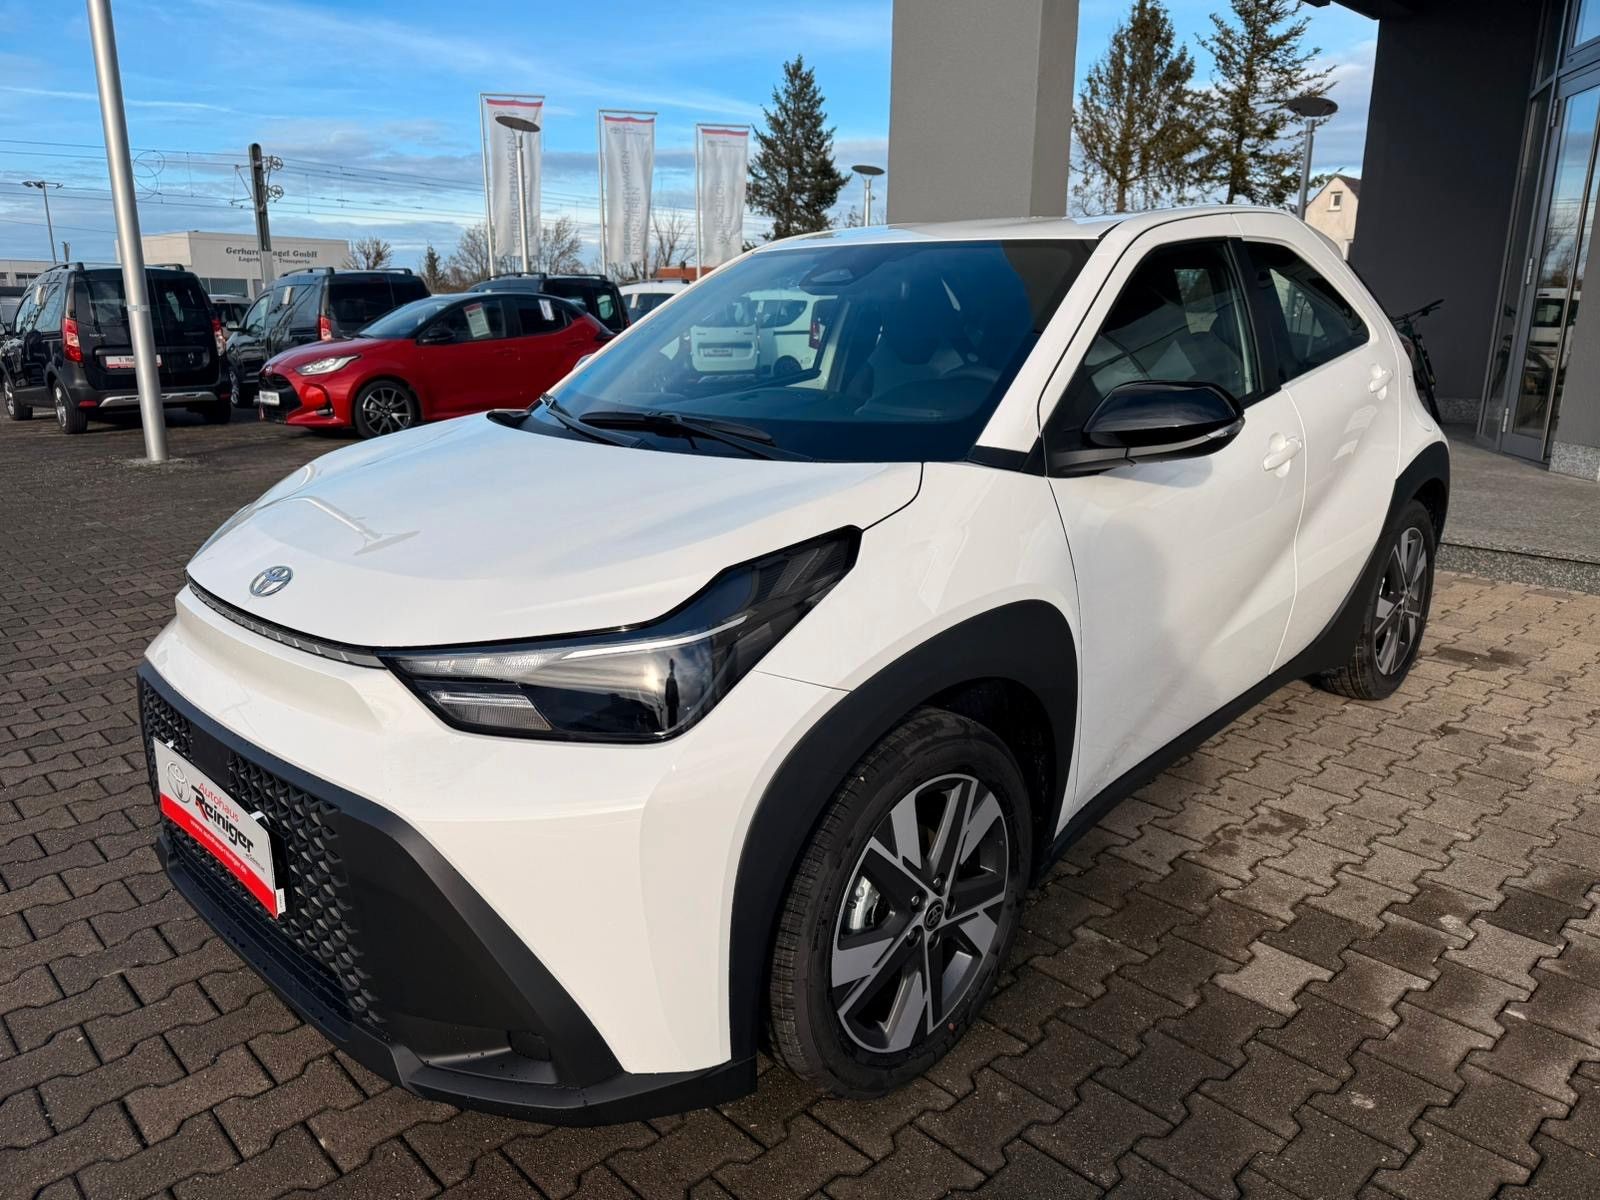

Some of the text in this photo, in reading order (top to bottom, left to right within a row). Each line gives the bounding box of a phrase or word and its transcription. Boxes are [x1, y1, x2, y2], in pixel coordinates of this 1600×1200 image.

[272, 249, 291, 258] agel
[292, 249, 318, 258] GmbH
[191, 784, 254, 853] Reiniger
[198, 782, 240, 823] Autohaus
